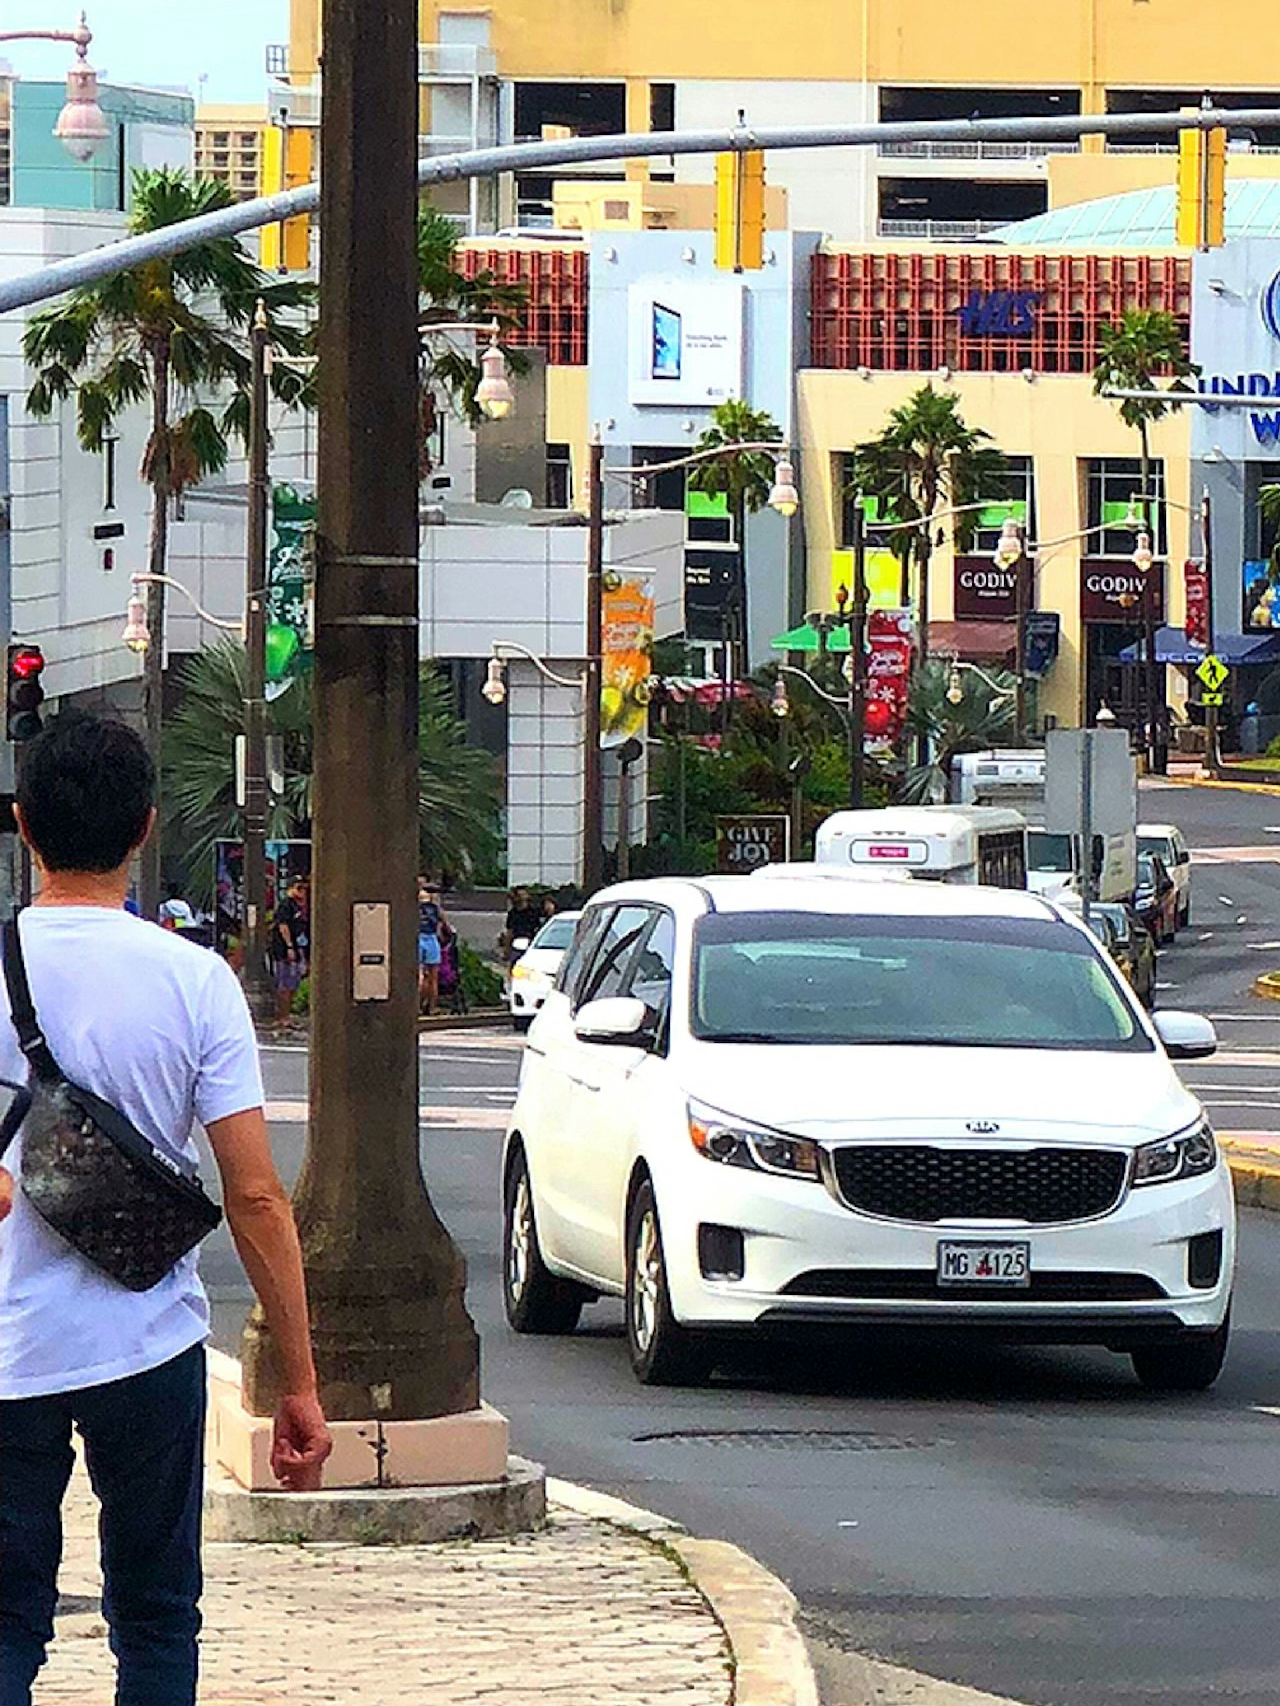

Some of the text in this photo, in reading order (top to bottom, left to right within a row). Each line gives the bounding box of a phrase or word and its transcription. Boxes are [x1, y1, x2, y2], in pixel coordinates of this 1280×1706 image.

[960, 571, 1018, 588] GODIV
[1086, 575, 1148, 592] GODIV
[727, 826, 776, 842] GIVE
[729, 843, 770, 863] JOY
[945, 1252, 969, 1276] MG
